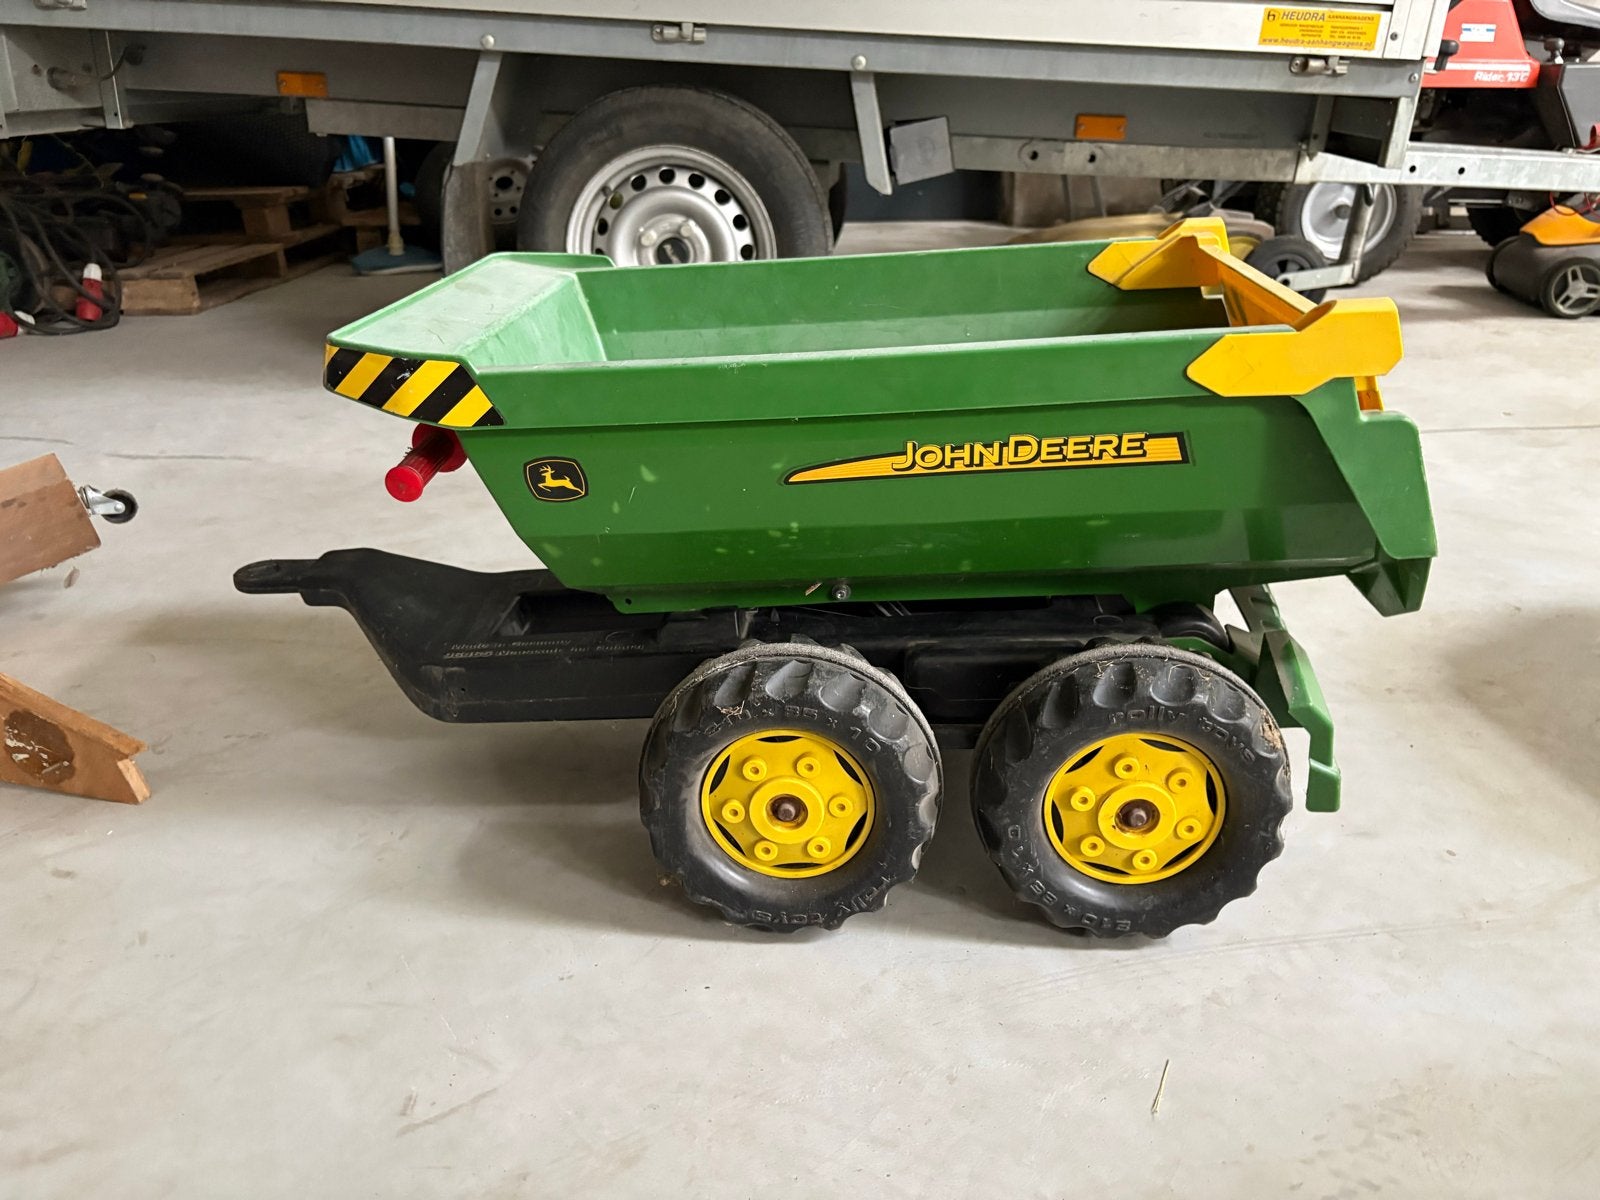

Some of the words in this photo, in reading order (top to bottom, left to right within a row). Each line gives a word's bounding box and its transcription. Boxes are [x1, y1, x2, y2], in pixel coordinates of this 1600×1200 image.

[1281, 11, 1326, 22] HEUDRA
[891, 440, 1002, 472] JOHN
[1006, 432, 1149, 466] DEERE
